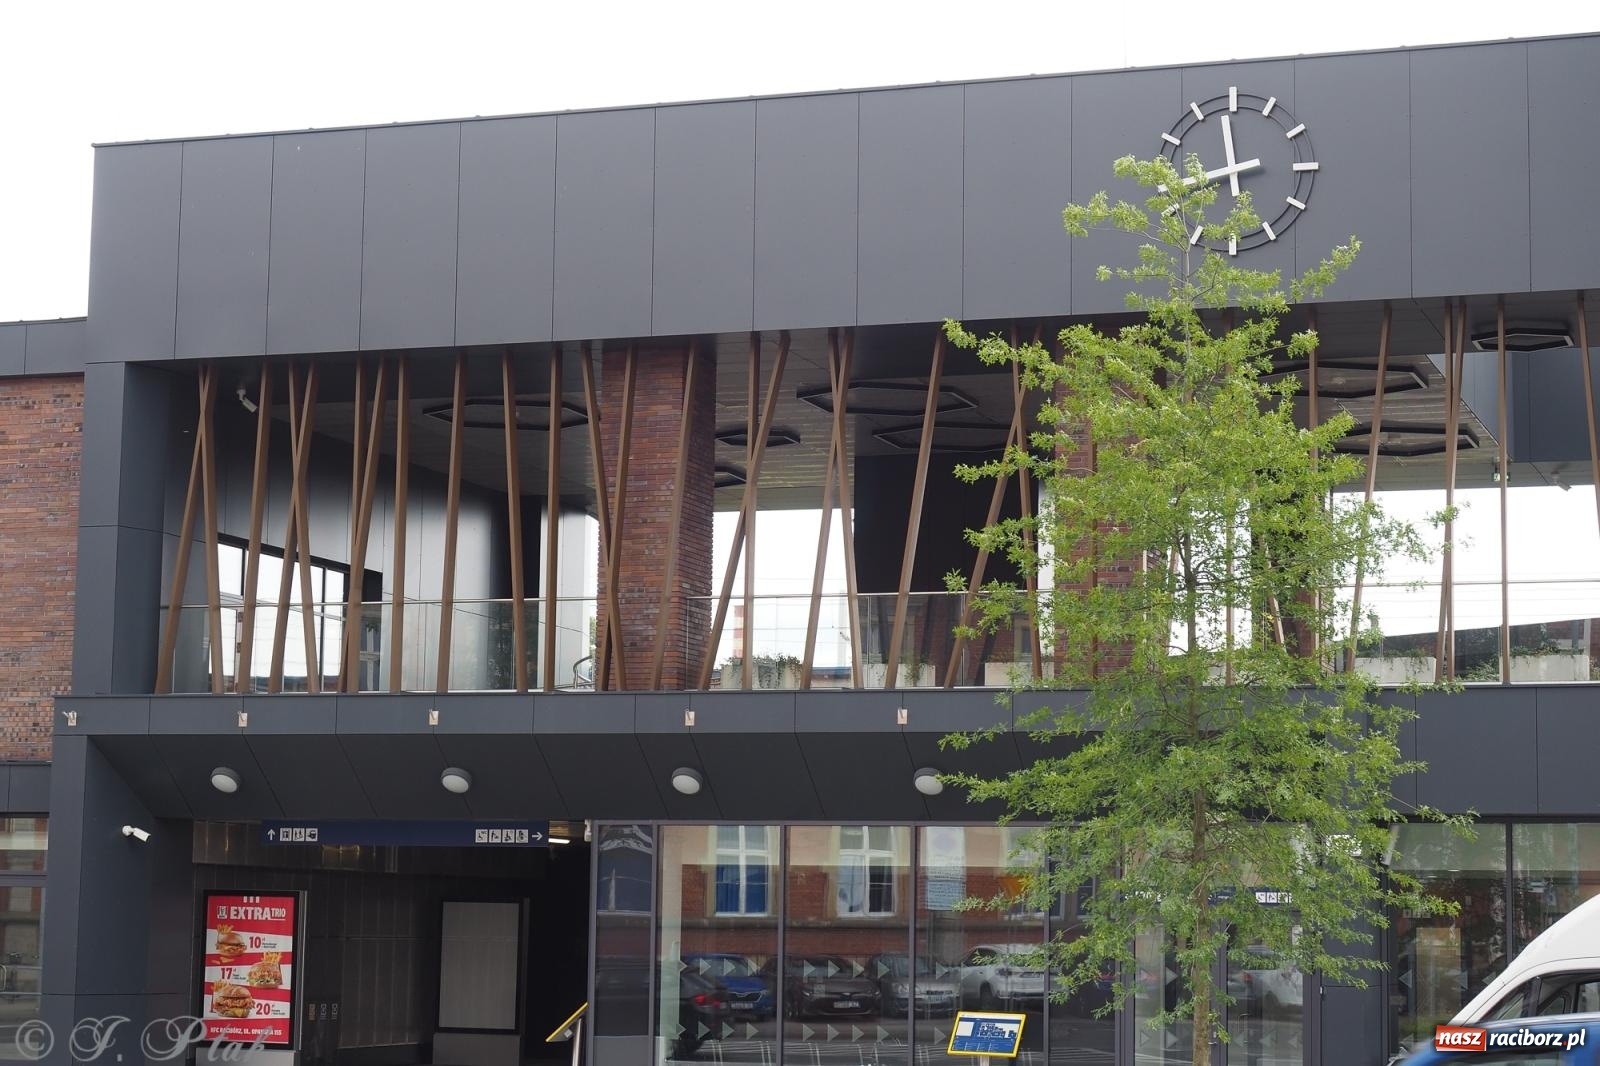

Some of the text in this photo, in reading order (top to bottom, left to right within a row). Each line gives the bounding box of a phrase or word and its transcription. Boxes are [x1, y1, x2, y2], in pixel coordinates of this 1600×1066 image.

[230, 906, 271, 920] EXTRA
[271, 907, 286, 918] TRIO
[249, 936, 261, 948] 10
[221, 967, 232, 979] 17
[256, 1003, 270, 1015] 20
